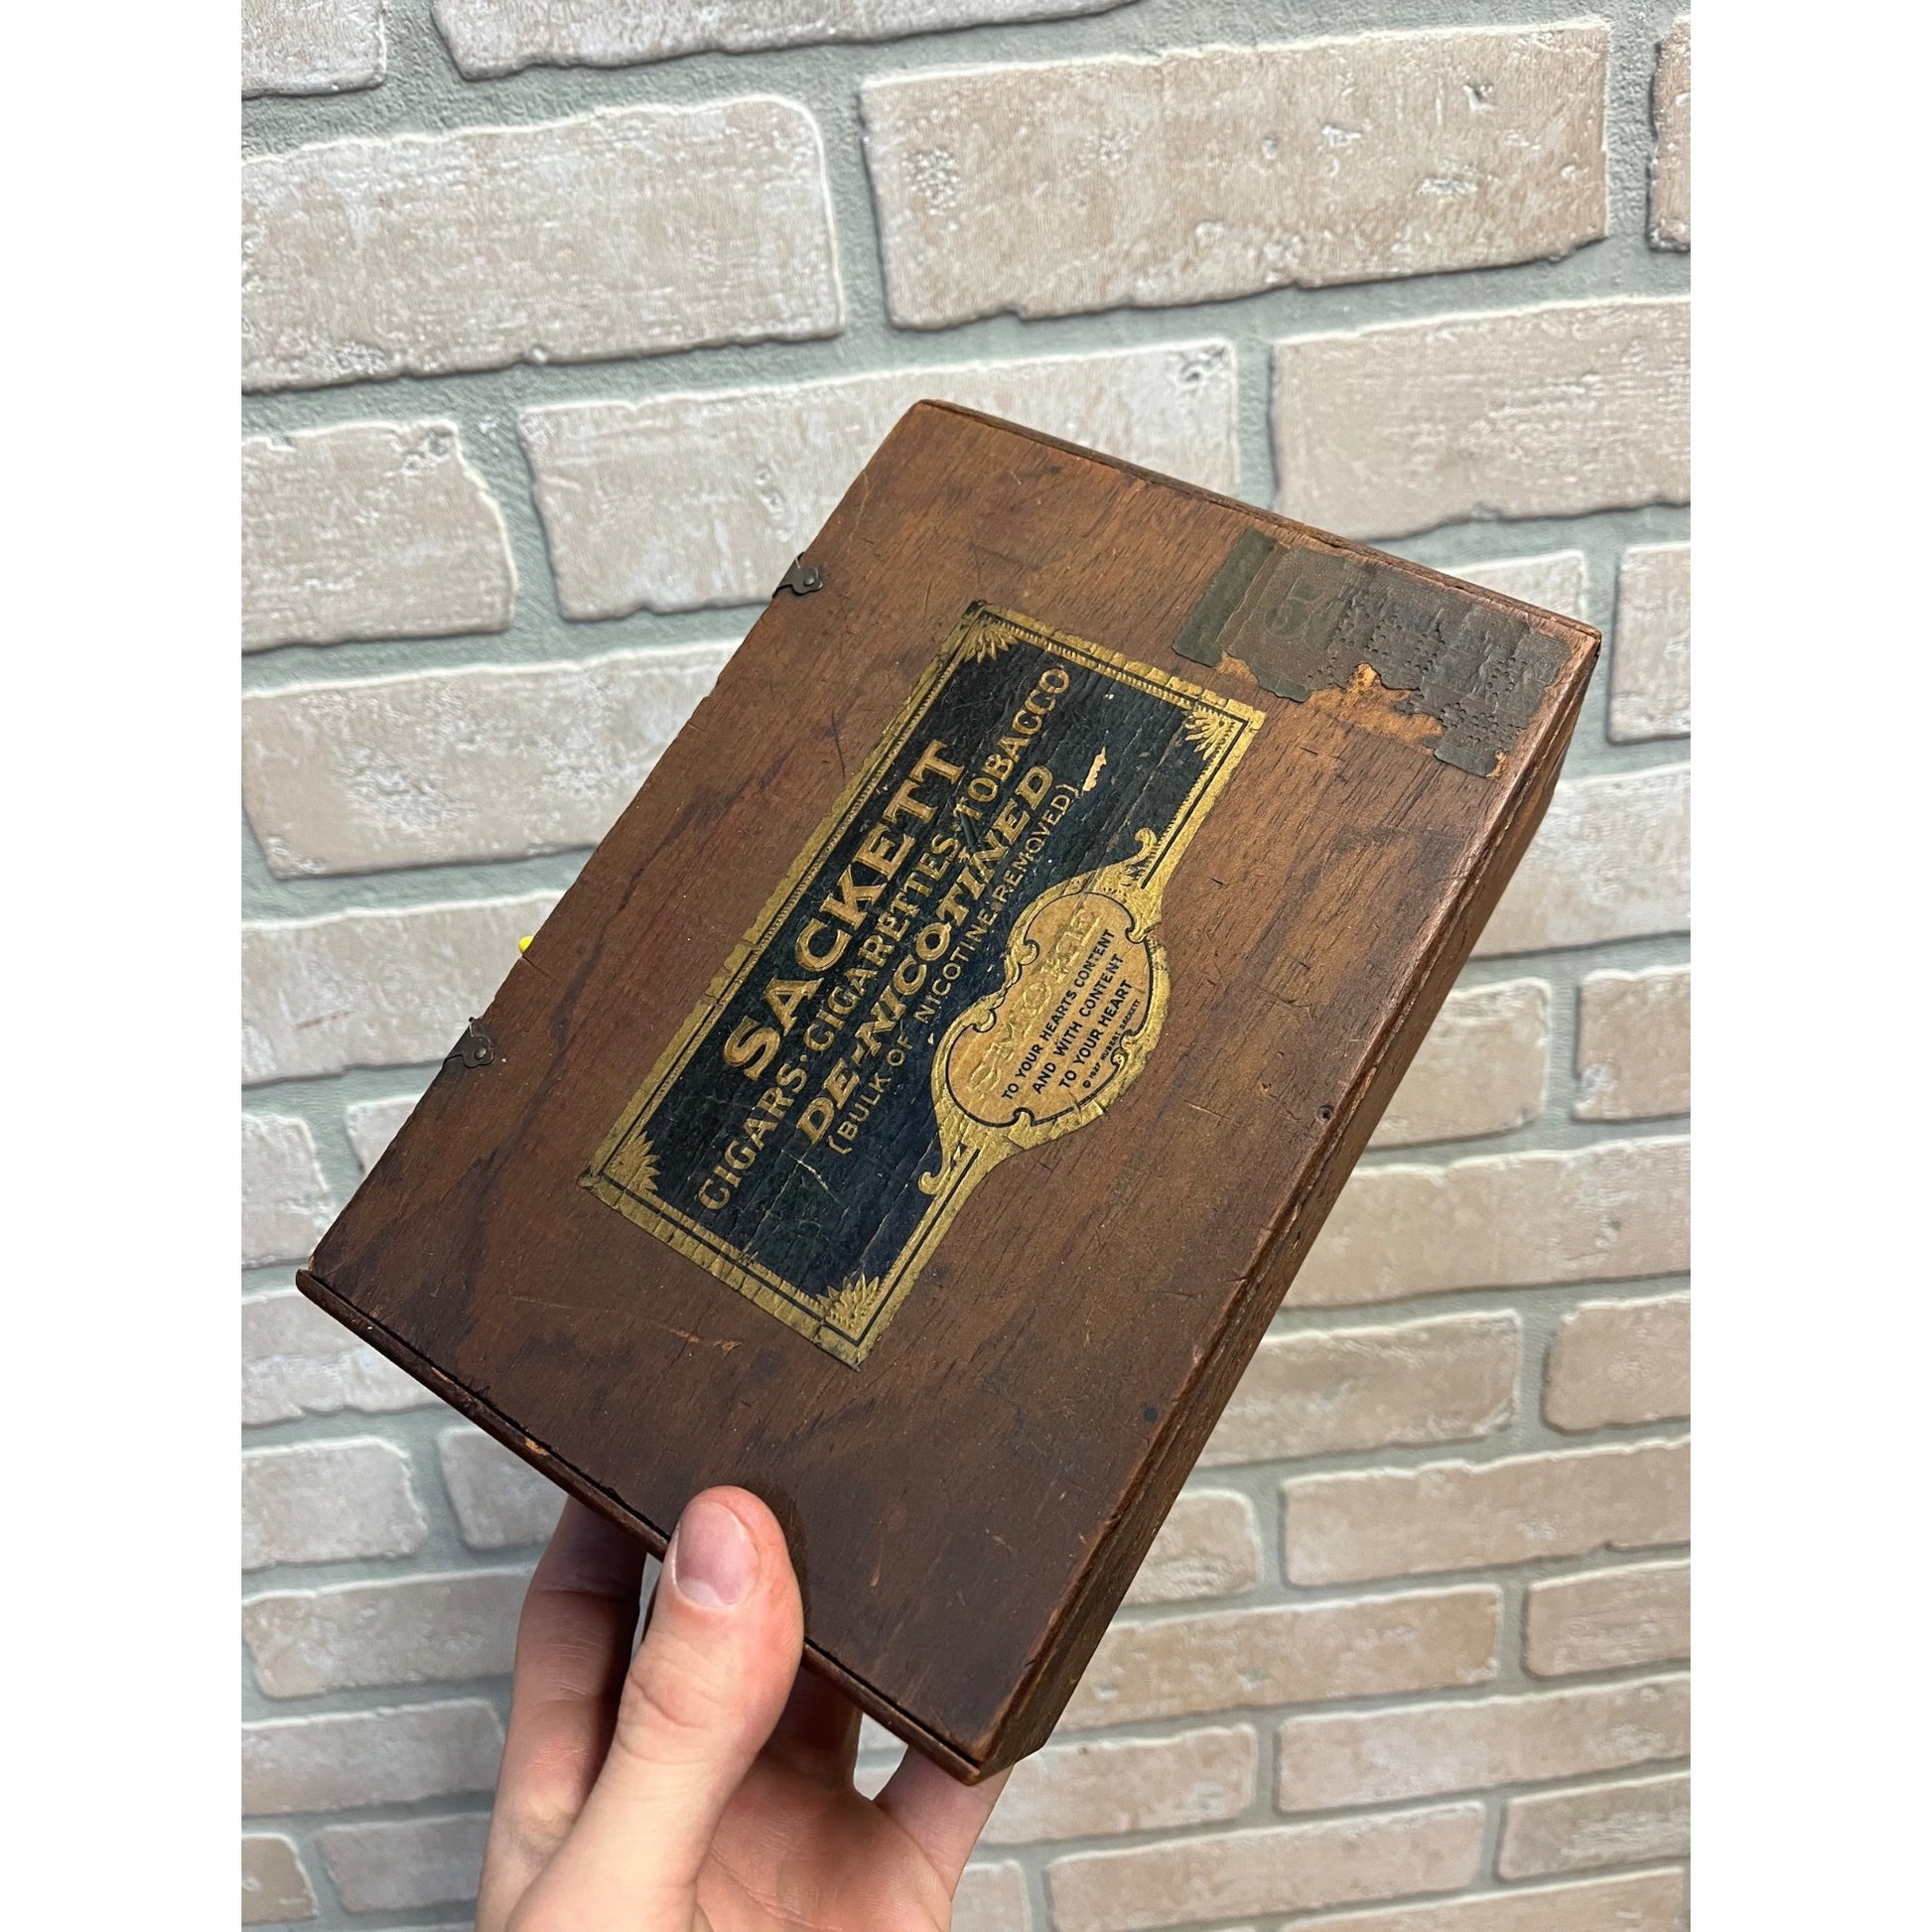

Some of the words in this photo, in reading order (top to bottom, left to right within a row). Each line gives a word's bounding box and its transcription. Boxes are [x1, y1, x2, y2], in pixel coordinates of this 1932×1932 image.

[697, 1061, 807, 1209] CIGARS
[803, 832, 962, 1051] CIGARETTES
[952, 667, 1069, 820] TOBACCO
[723, 738, 965, 1081] SACKETT
[795, 764, 1053, 1145] DE-NICOTINED
[827, 1071, 892, 1155] (BULK
[886, 1031, 913, 1066] OF
[912, 905, 1000, 1023] NICOTINE
[991, 782, 1079, 903] REMOVED)
[1000, 1082, 1020, 1100] TO
[1014, 1042, 1044, 1078] YOUR
[1037, 989, 1077, 1041] HEARTS
[1072, 927, 1115, 988] CONTENT
[1032, 1061, 1056, 1095] AND
[1052, 1020, 1083, 1056] WITH
[1078, 952, 1124, 1018] CONTENT
[1057, 1069, 1077, 1088] TO
[1071, 1028, 1105, 1065] YOUR
[1096, 978, 1133, 1028] HEART
